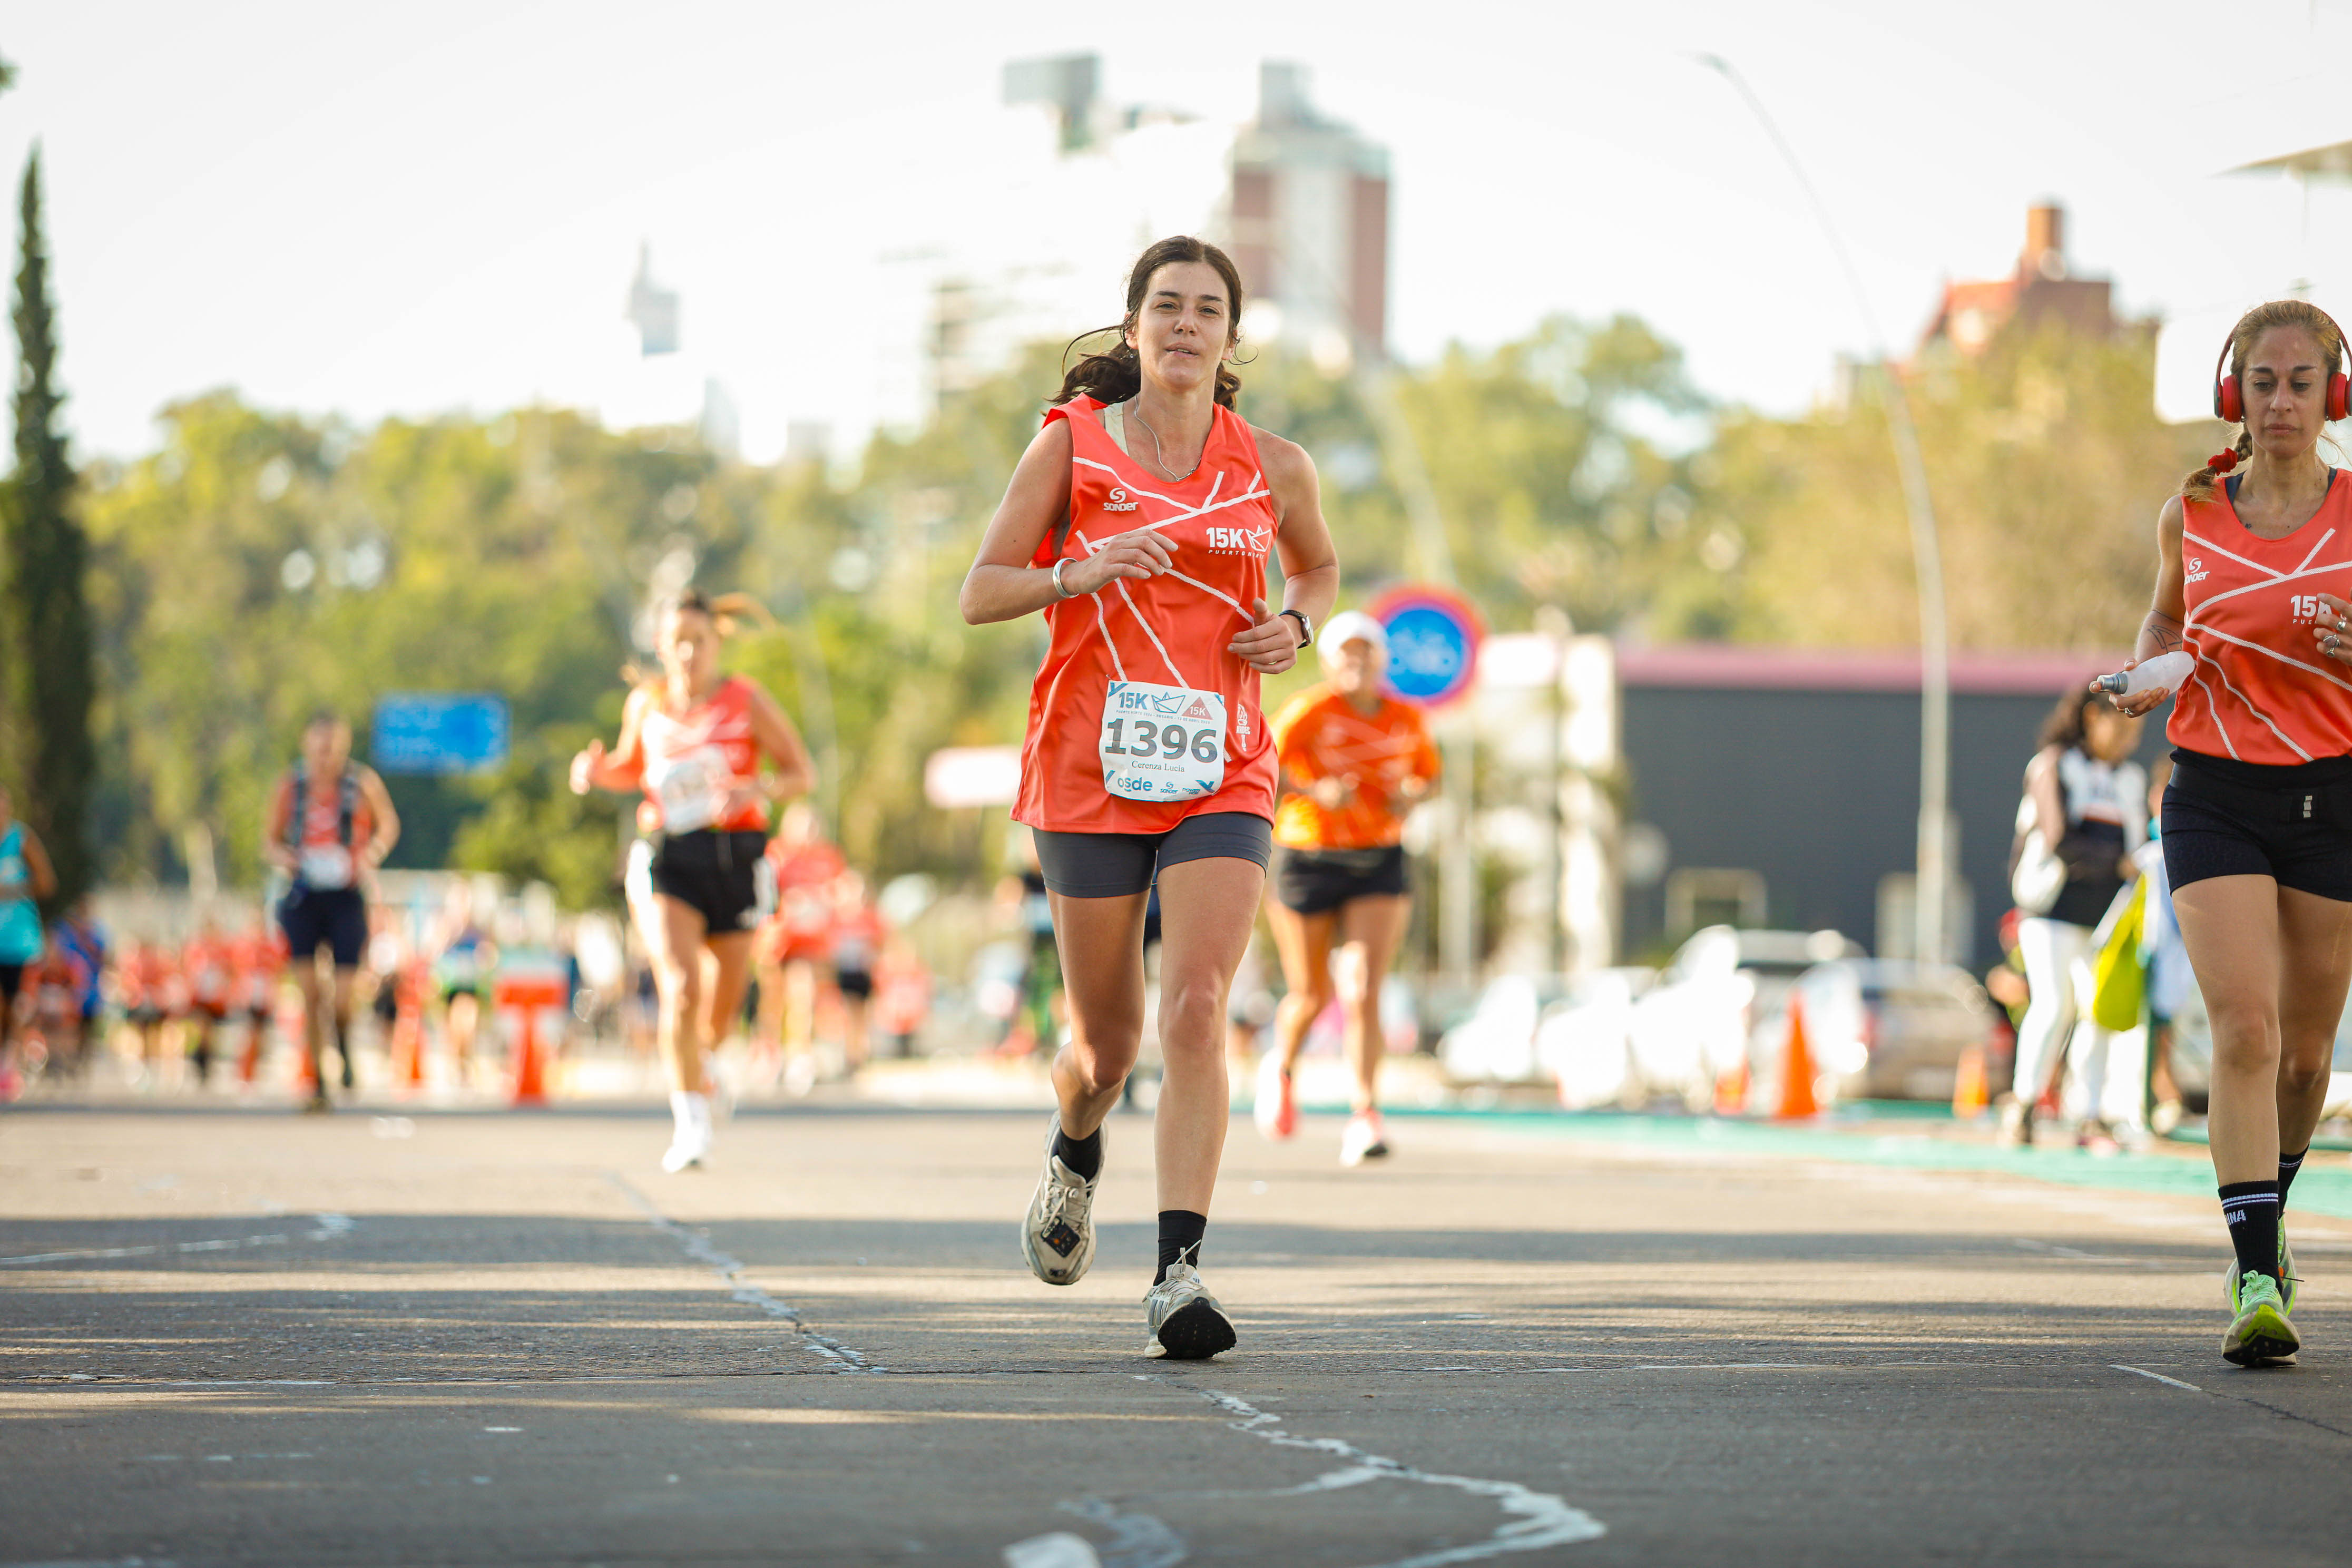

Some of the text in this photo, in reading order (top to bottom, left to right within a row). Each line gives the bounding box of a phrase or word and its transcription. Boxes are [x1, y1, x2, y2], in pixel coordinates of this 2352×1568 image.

[1206, 527, 1246, 548] 15K
[2184, 571, 2210, 585] ONDER
[1119, 692, 1149, 710] 15K
[1190, 706, 1206, 716] 15K
[1105, 718, 1218, 763] 1396
[1132, 760, 1162, 770] Cerenza
